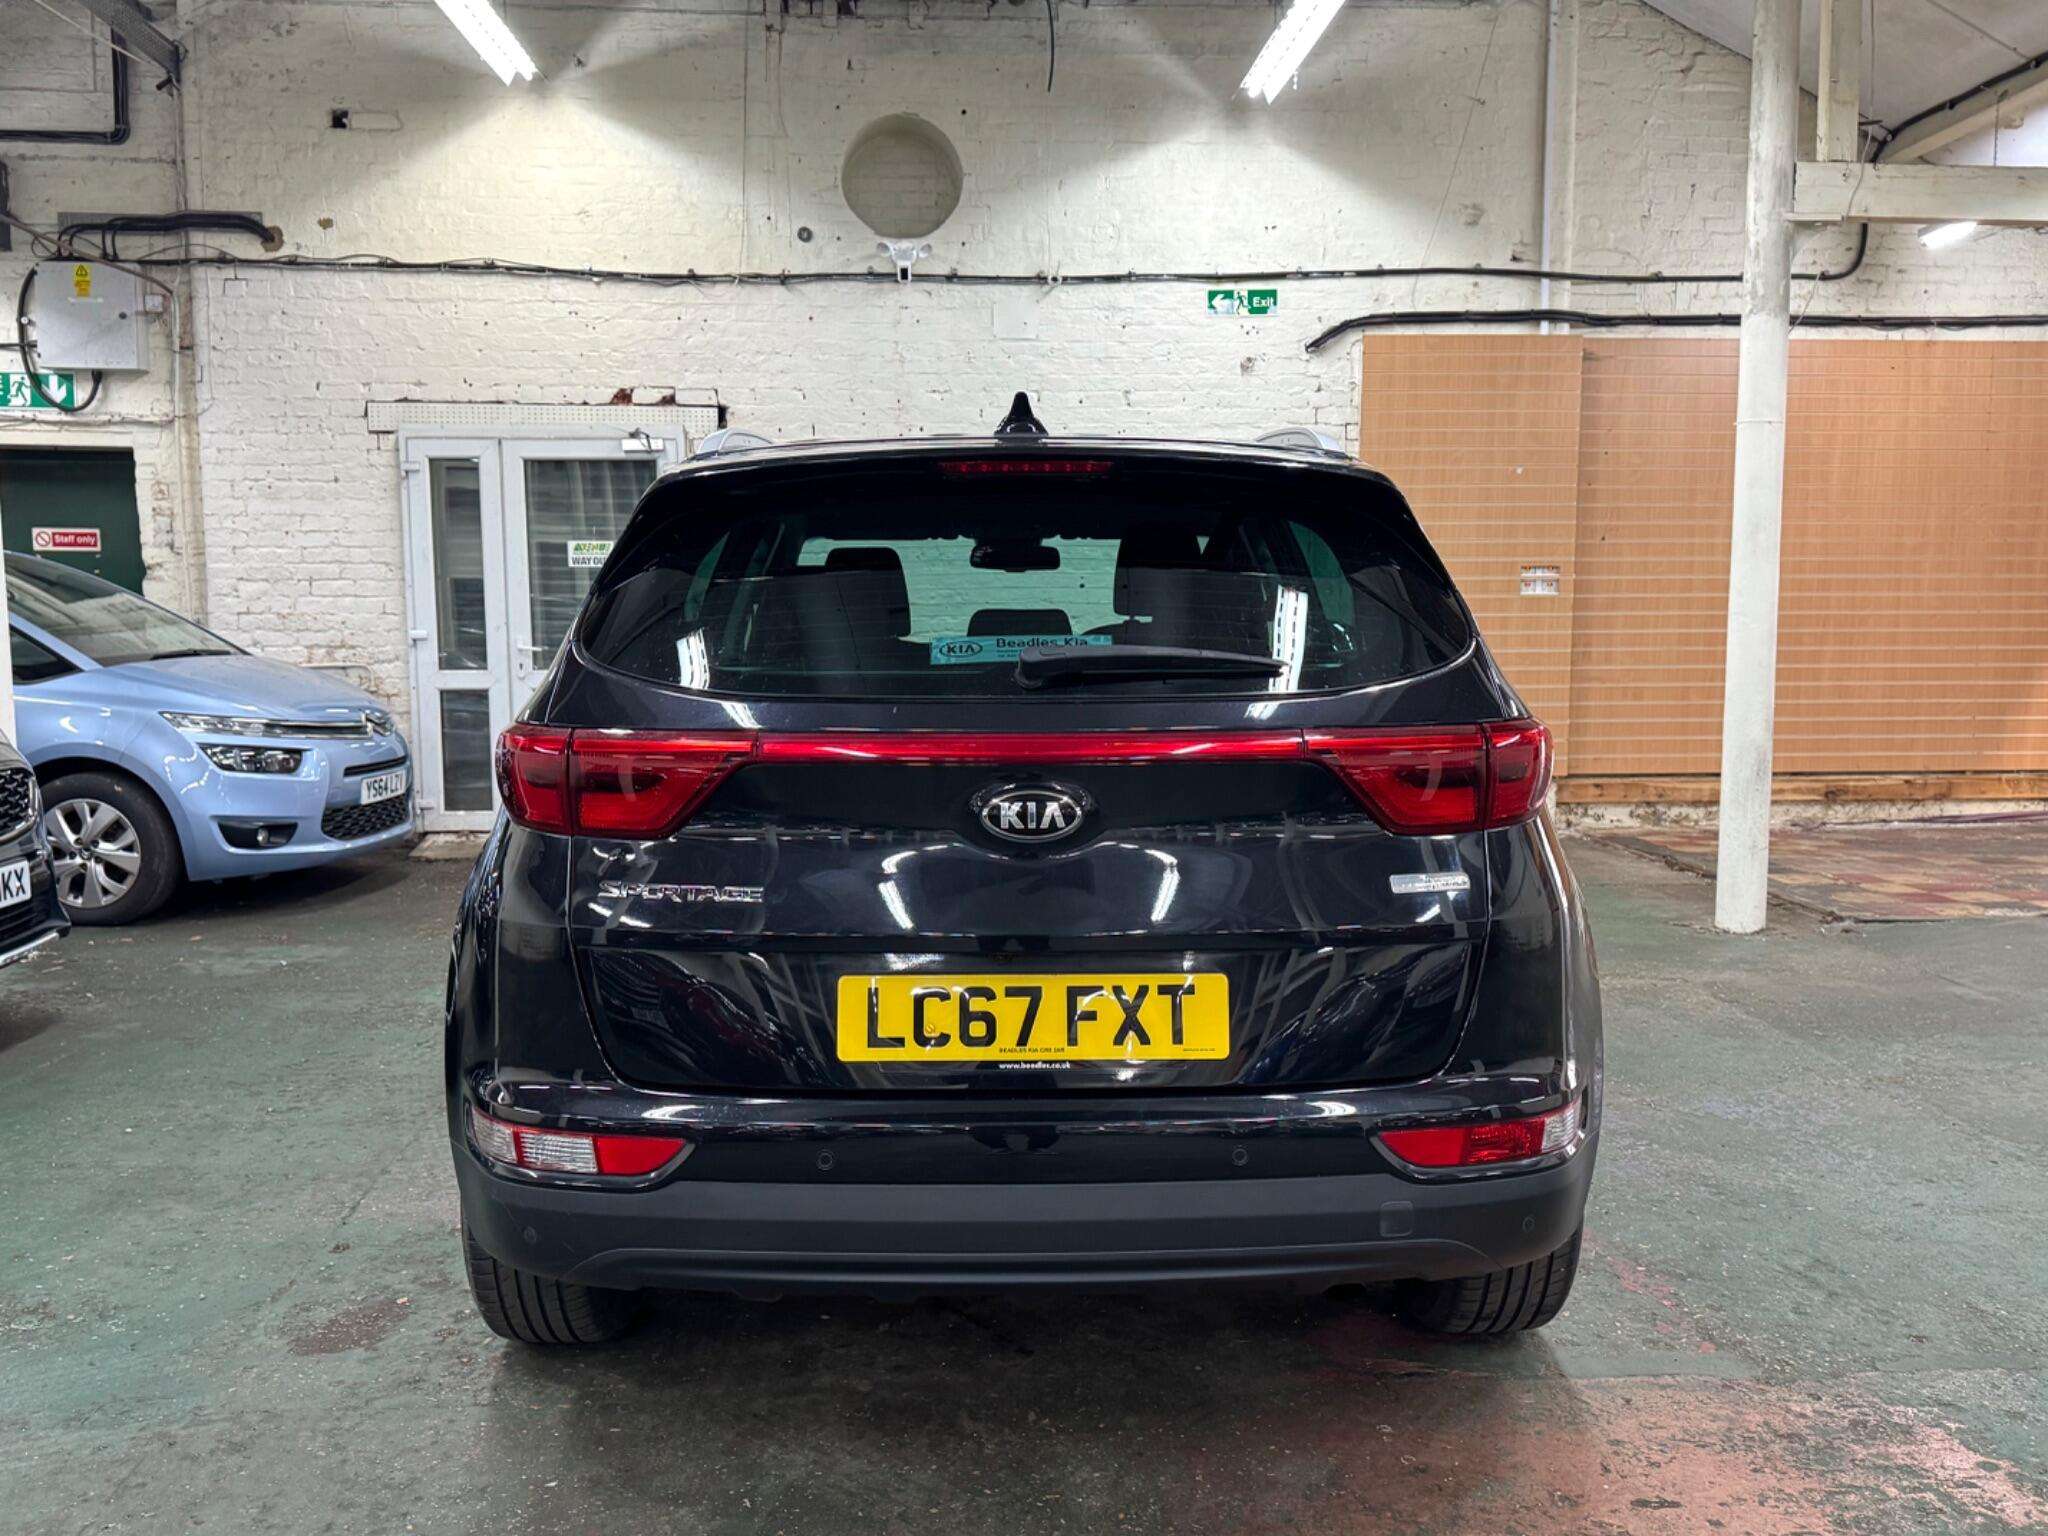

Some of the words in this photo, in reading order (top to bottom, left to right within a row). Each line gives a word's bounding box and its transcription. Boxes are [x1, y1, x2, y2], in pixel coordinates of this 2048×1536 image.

[1253, 296, 1274, 307] Exit
[54, 535, 75, 543] Staff
[76, 535, 96, 545] only
[571, 556, 592, 565] WAY
[594, 556, 608, 565] OU
[946, 642, 978, 655] KIA
[996, 637, 1057, 648] Beadles
[1064, 636, 1088, 647] Kia
[366, 775, 388, 800] YS64
[1000, 801, 1066, 829] KIA
[0, 867, 26, 901] KX
[597, 880, 764, 903] SPORTAGE
[867, 986, 1043, 1049] LC67
[1066, 984, 1195, 1047] FXT
[998, 1061, 1071, 1069] www.beadles.co.uk
